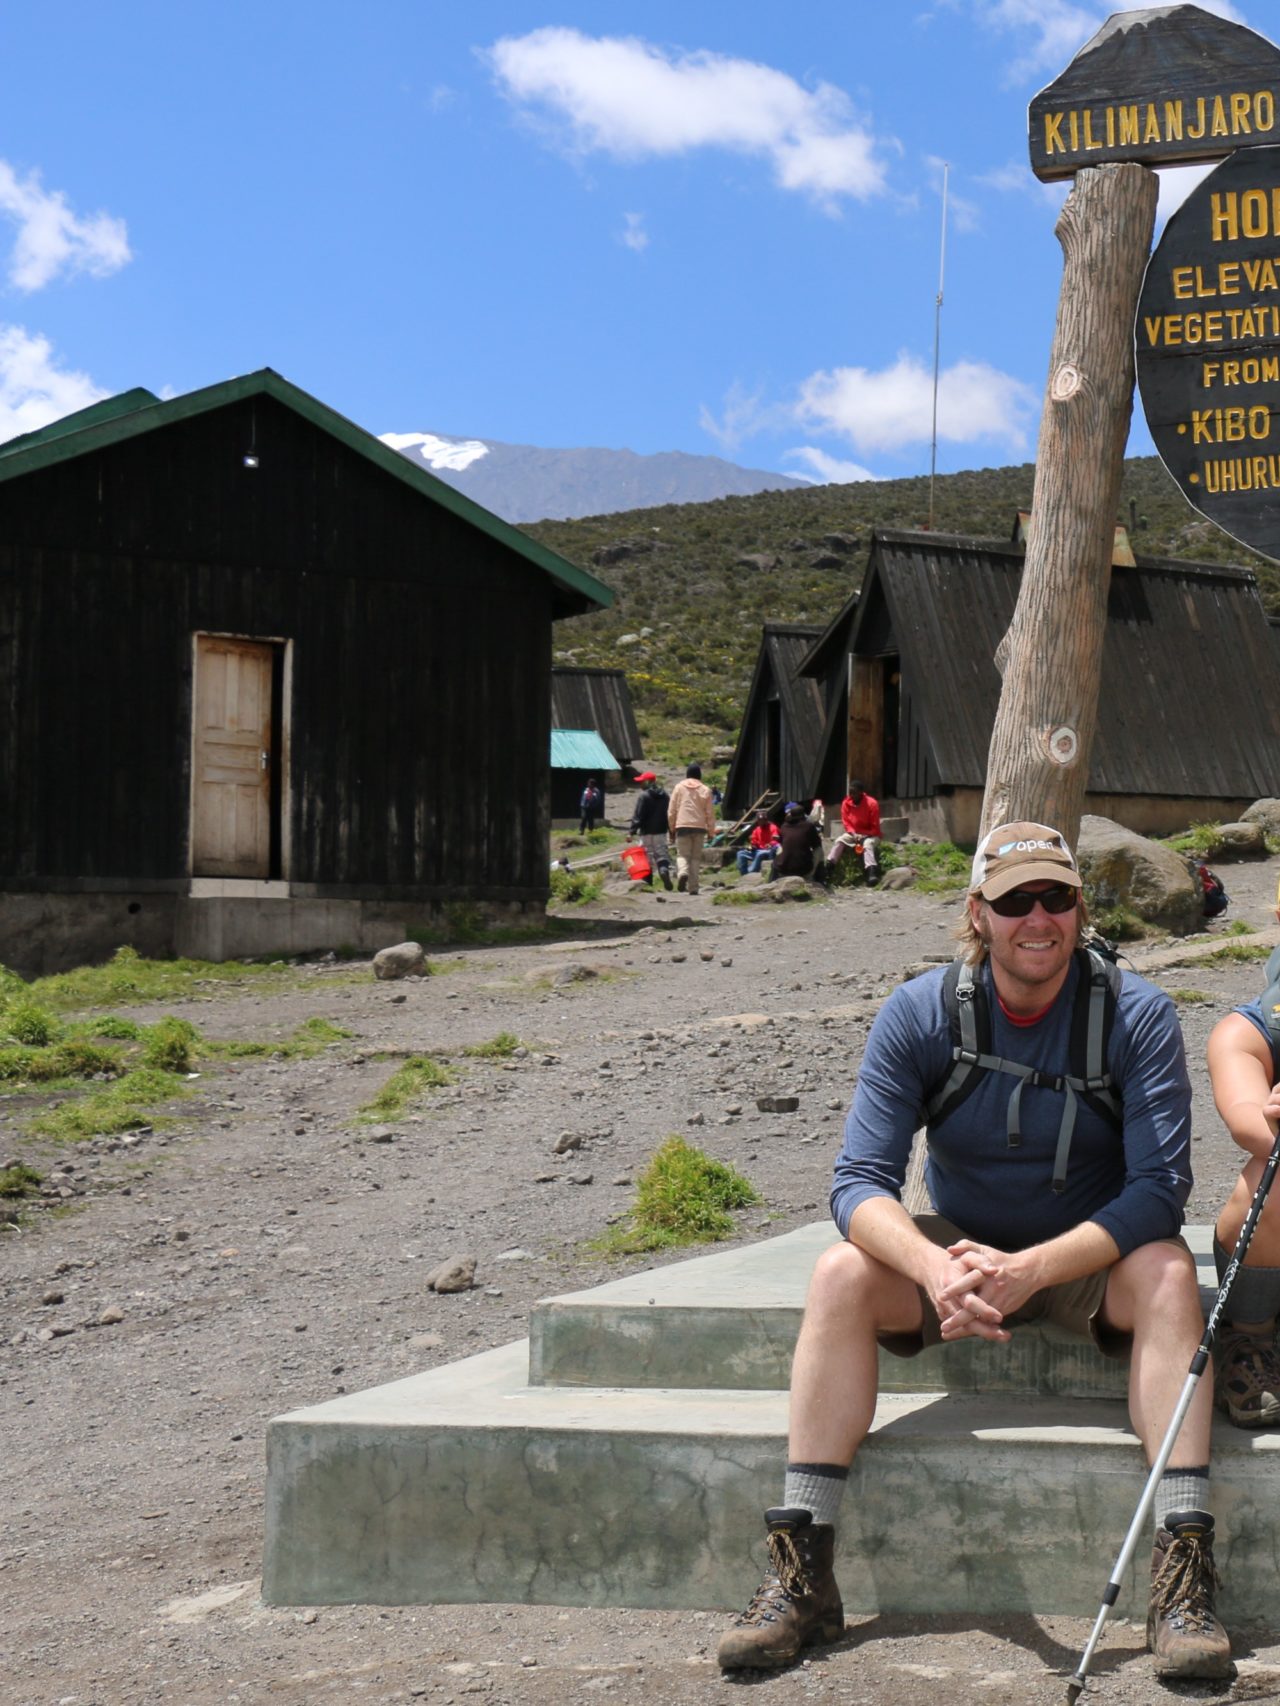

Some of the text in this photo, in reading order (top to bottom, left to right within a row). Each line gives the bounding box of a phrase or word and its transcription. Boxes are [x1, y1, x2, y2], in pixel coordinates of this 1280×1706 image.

[1044, 90, 1275, 155] KILIMANJARO
[1203, 355, 1280, 388] FROM
[1191, 405, 1271, 444] KIBO
[1016, 840, 1054, 852] open
